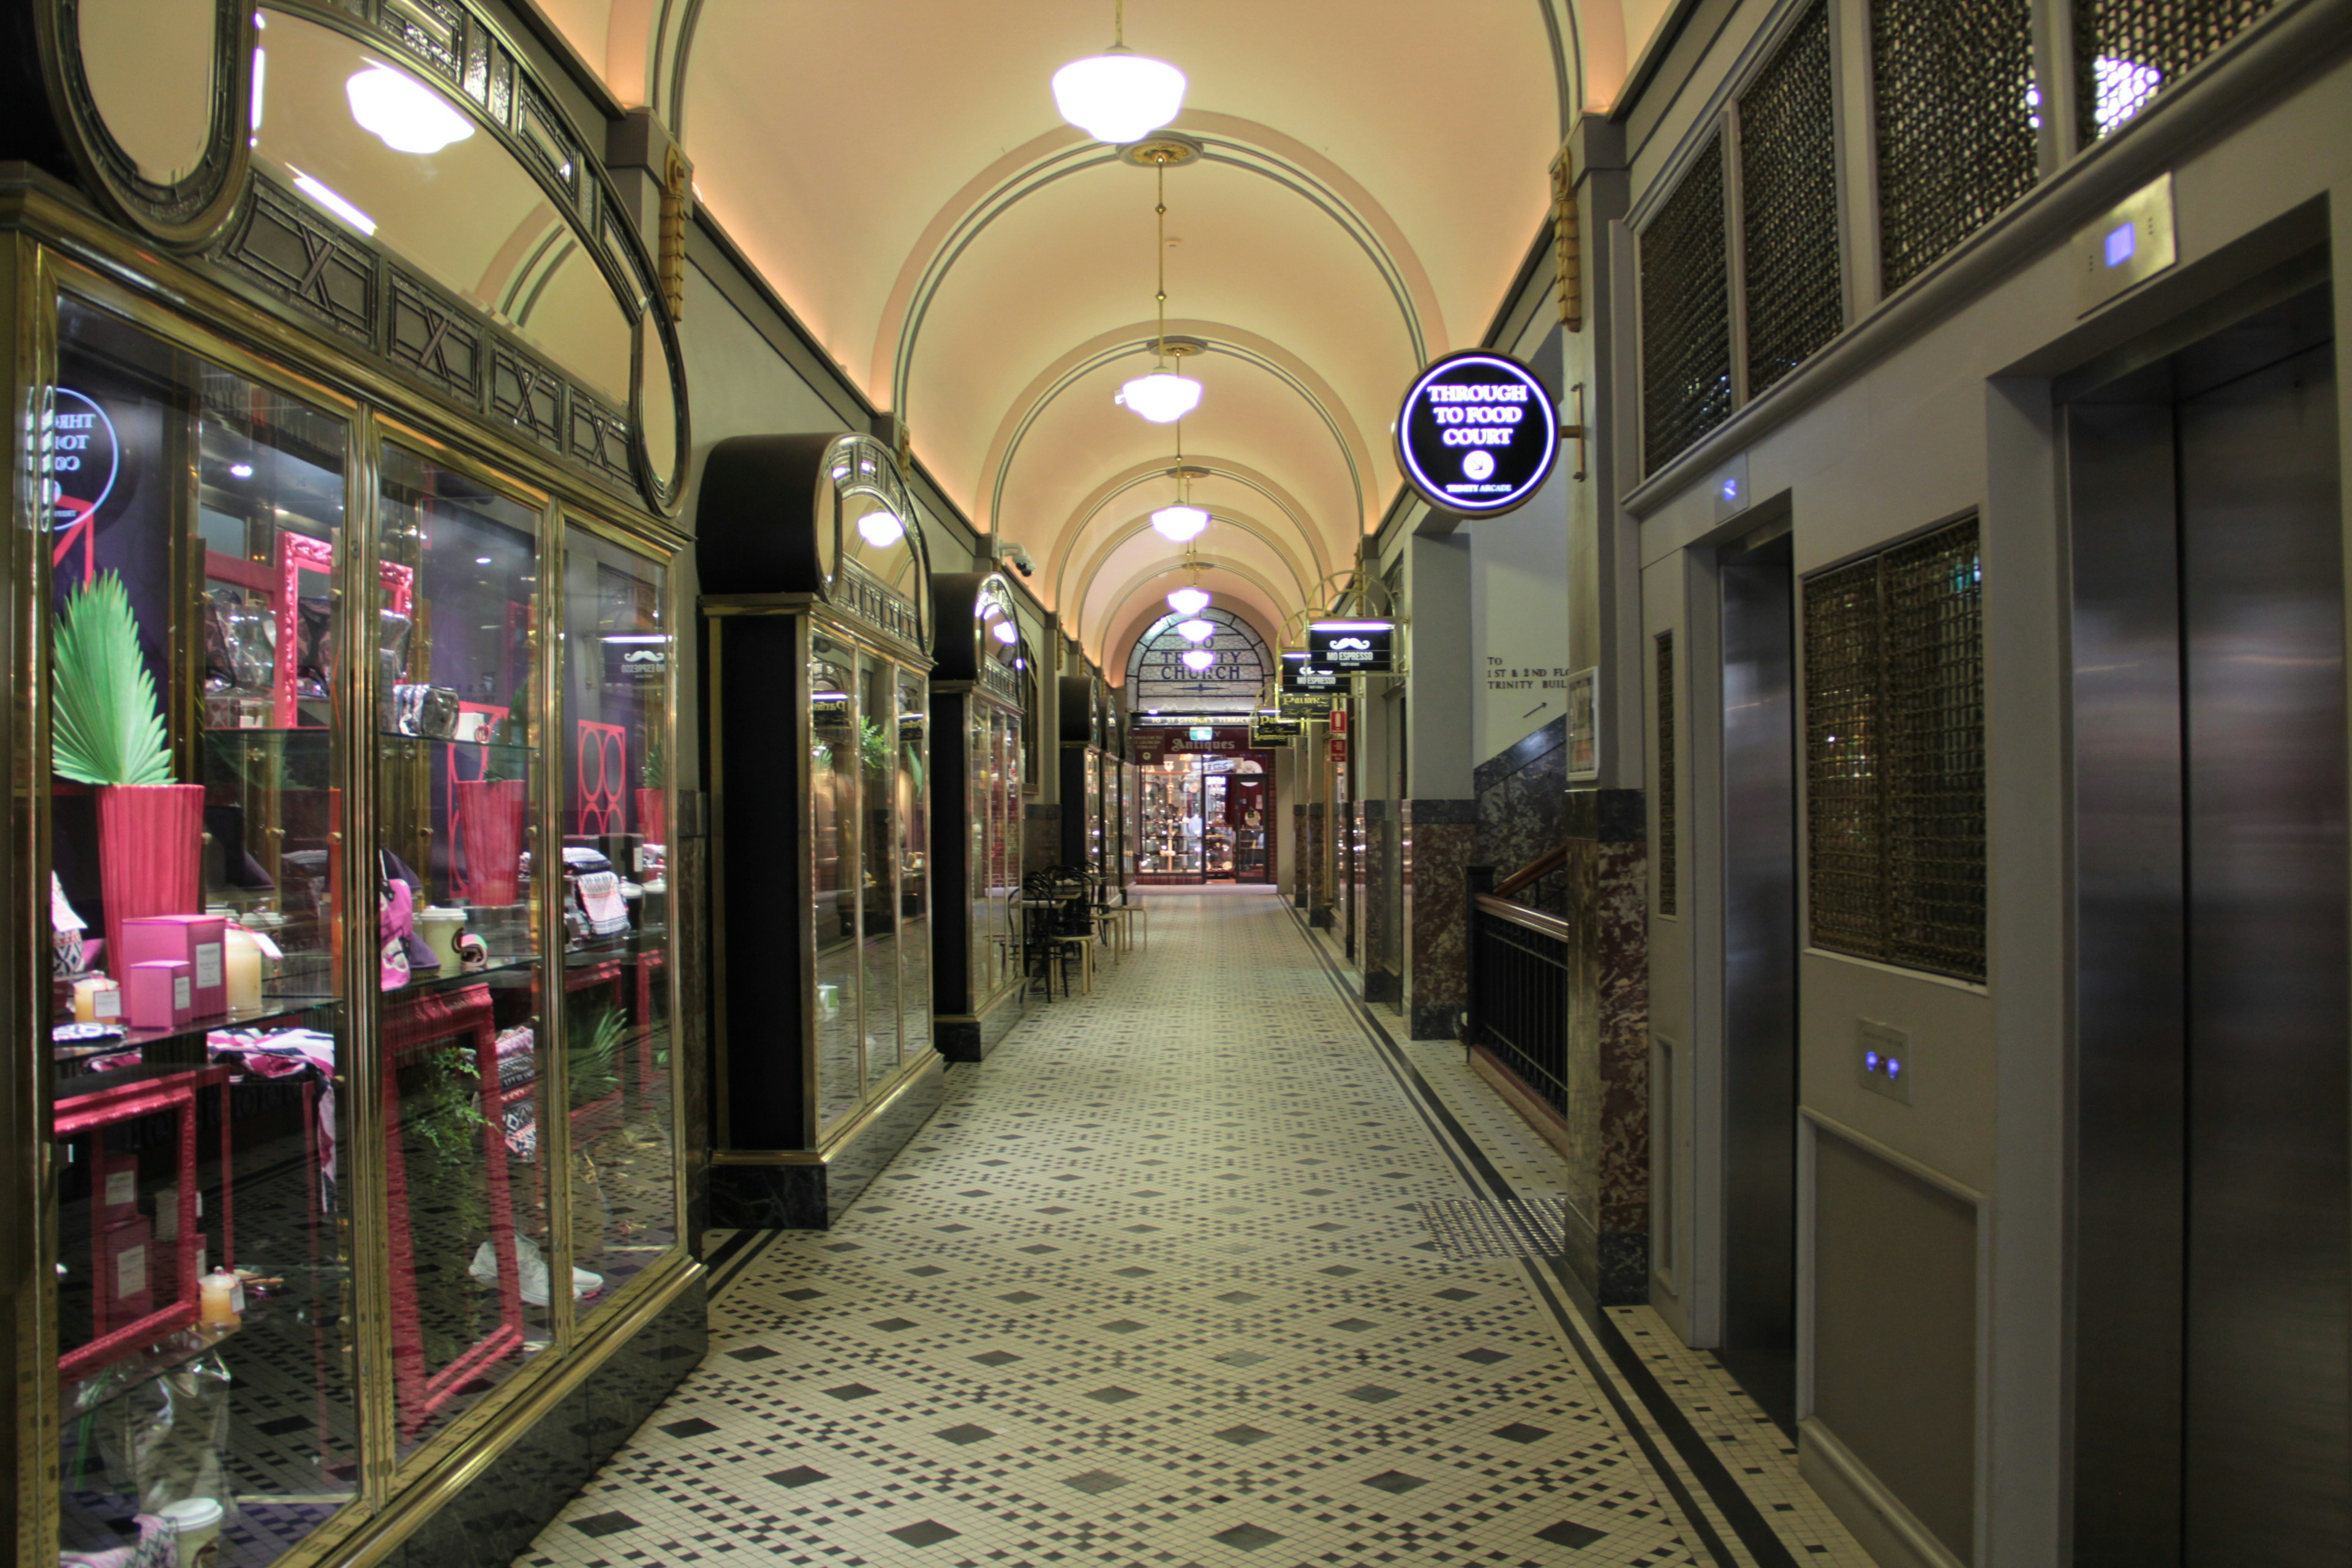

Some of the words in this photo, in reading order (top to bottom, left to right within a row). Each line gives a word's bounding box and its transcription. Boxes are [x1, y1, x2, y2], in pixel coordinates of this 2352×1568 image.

[1427, 385, 1528, 402] THROUGH
[1433, 406, 1464, 423] TO
[1466, 406, 1523, 423] FOOD
[1442, 428, 1513, 445] COURT
[1161, 652, 1241, 664] TRTY
[1326, 652, 1338, 661] MO
[1338, 652, 1373, 661] ESPRESSO
[1487, 657, 1503, 665] TO
[1161, 666, 1241, 680] CHURCH
[1488, 680, 1534, 690] TRINITY
[1170, 738, 1235, 752] Antiques
